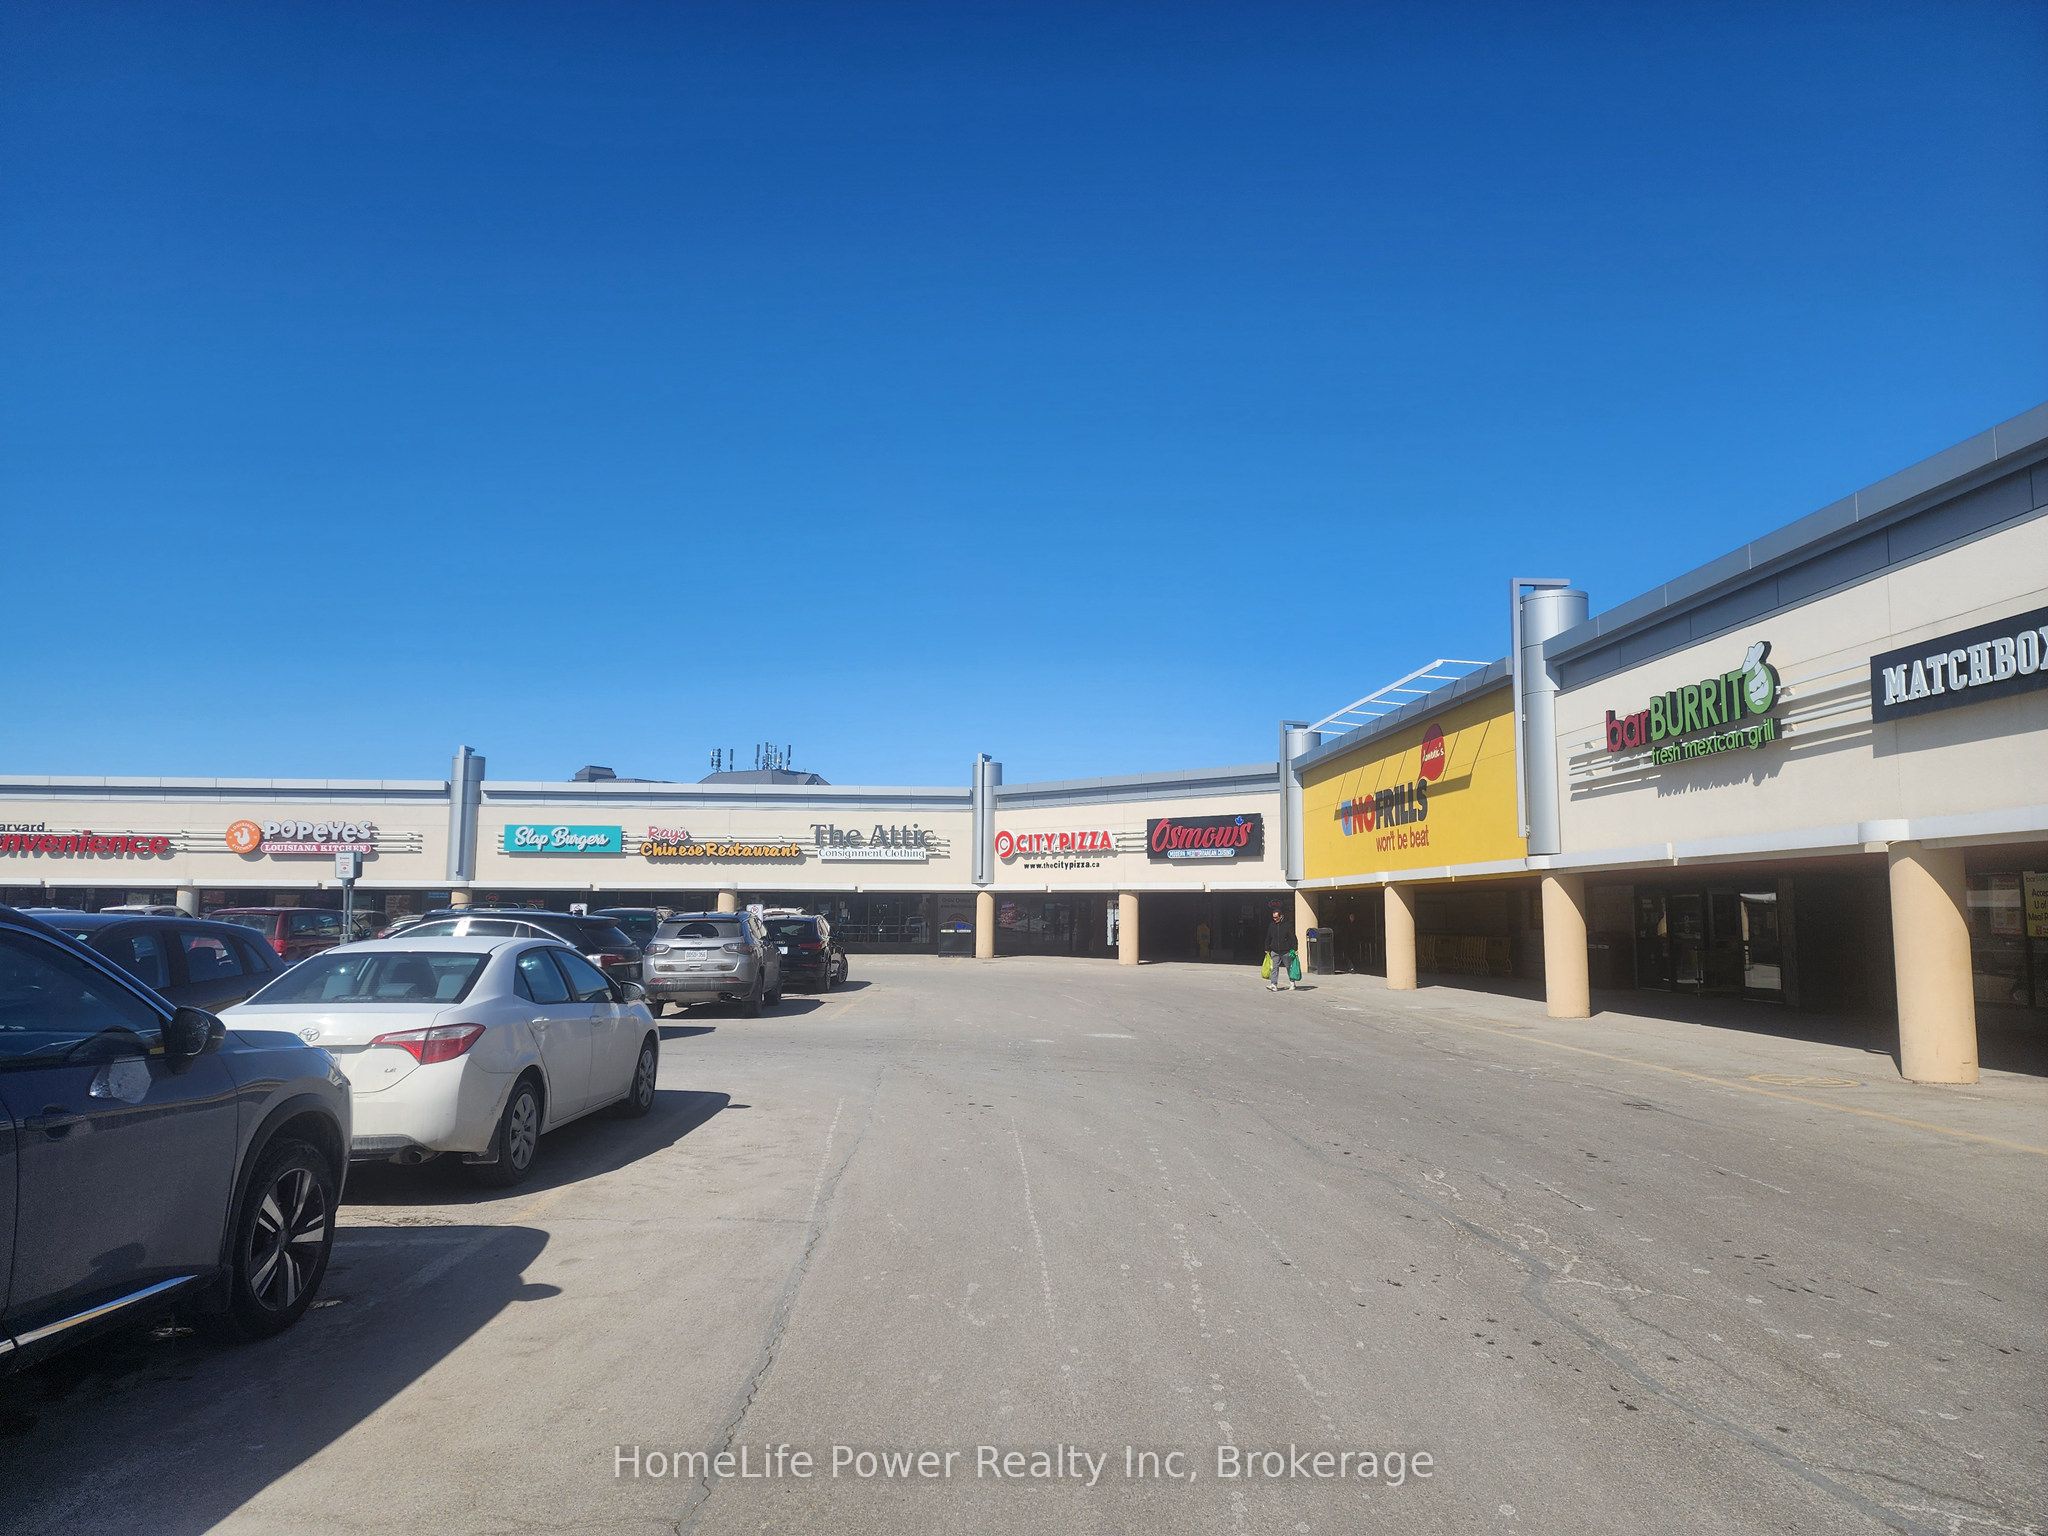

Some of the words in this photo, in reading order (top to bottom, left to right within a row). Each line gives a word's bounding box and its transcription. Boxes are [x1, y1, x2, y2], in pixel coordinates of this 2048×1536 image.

[1652, 742, 1681, 766] fresh
[1684, 730, 1745, 759] mexican
[1748, 717, 1776, 750] grill
[0, 830, 170, 853] nvenience
[514, 826, 550, 851] Slap
[550, 827, 610, 851] Burgers
[647, 826, 689, 845] Ray's
[810, 823, 862, 847] The
[869, 823, 935, 847] Attic
[1016, 832, 1056, 853] CITY
[1059, 830, 1113, 850] PIZZA
[1397, 829, 1408, 850] be
[1410, 825, 1430, 848] beat
[320, 844, 367, 852] KITCHEN
[639, 842, 705, 857] Chinese
[705, 842, 801, 857] Restaurant
[818, 849, 883, 859] Consignment
[885, 849, 925, 859] Clothing
[1024, 860, 1100, 870] www.thecitypizza.ca
